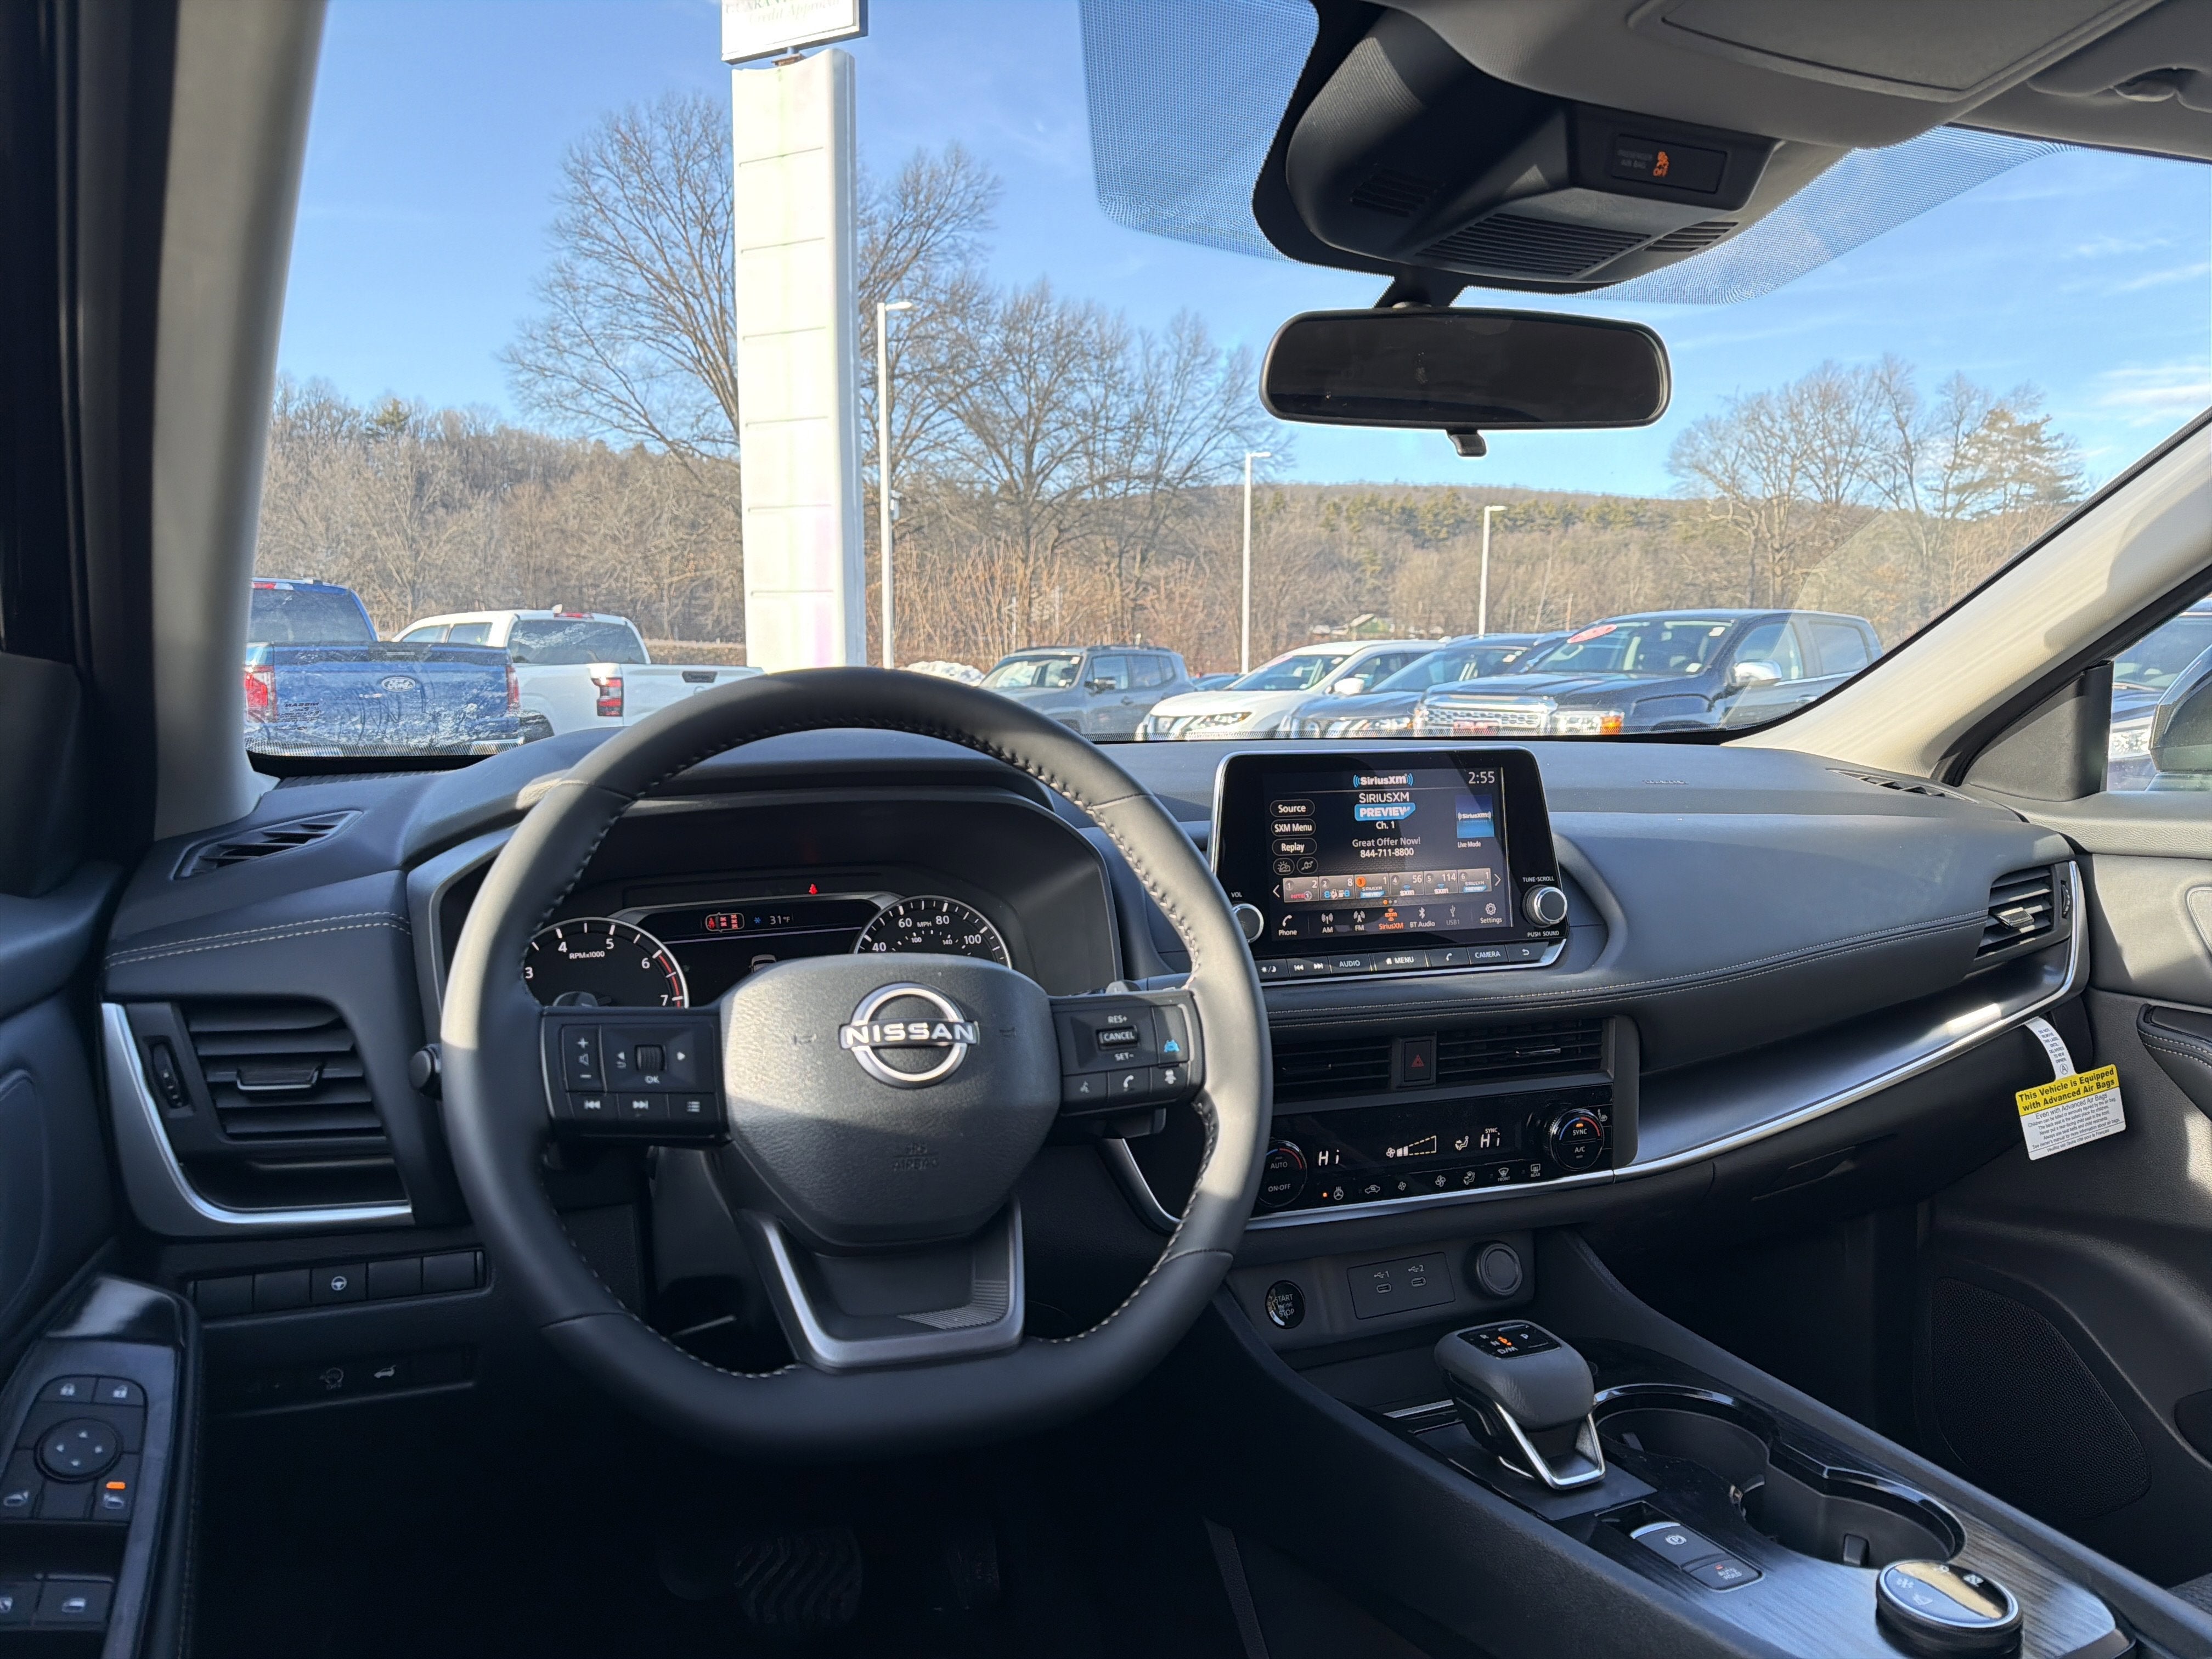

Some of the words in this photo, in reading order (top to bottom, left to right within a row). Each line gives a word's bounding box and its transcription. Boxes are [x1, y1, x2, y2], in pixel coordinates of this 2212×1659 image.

[1468, 771, 1495, 784] 2:55
[1359, 792, 1409, 803] SIRIUSXM
[1278, 804, 1306, 814] Source
[1359, 806, 1410, 817] PREVIEW
[1274, 823, 1290, 833] SXM
[1292, 823, 1312, 832] Menu
[1376, 821, 1389, 830] Ch.
[1352, 838, 1375, 848] Great
[1377, 837, 1398, 847] Offer
[1400, 836, 1421, 845] Now!
[1281, 842, 1305, 853] Replay
[1360, 848, 1414, 858] 844-711-8800
[1383, 876, 1387, 884] 1
[1412, 874, 1423, 883] 56
[1442, 873, 1456, 882] 114
[1485, 871, 1489, 879] 1
[1312, 879, 1317, 889] 2
[1347, 878, 1353, 887] 8
[898, 917, 912, 928] 60
[935, 915, 950, 925] 80
[606, 938, 614, 949] 5
[963, 934, 981, 945] 100
[557, 941, 567, 952] 4
[872, 941, 887, 952] 40
[569, 951, 605, 960] RPMx1000
[1475, 951, 1501, 959] CAMERA
[641, 957, 650, 968] 6
[524, 967, 533, 979] 3
[660, 995, 669, 1007] 7
[845, 1022, 974, 1046] NISSAN
[1103, 1031, 1135, 1042] CANCEL
[645, 1075, 660, 1084] OK
[2018, 1092, 2037, 1102] This
[2039, 1083, 2068, 1096] Vehicle
[2079, 1068, 2114, 1084] Equipped
[2022, 1101, 2041, 1111] with
[2044, 1088, 2081, 1106] Advanced
[2084, 1085, 2094, 1093] Air
[2096, 1080, 2114, 1090] Bags
[2062, 1099, 2086, 1111] Advanced
[1572, 1128, 1588, 1136] SYNC
[1573, 1146, 1586, 1154] A/C
[1318, 1149, 1340, 1166] Hi
[1270, 1161, 1288, 1170] AUTO
[1274, 1294, 1293, 1303] START
[1279, 1308, 1295, 1317] STOP
